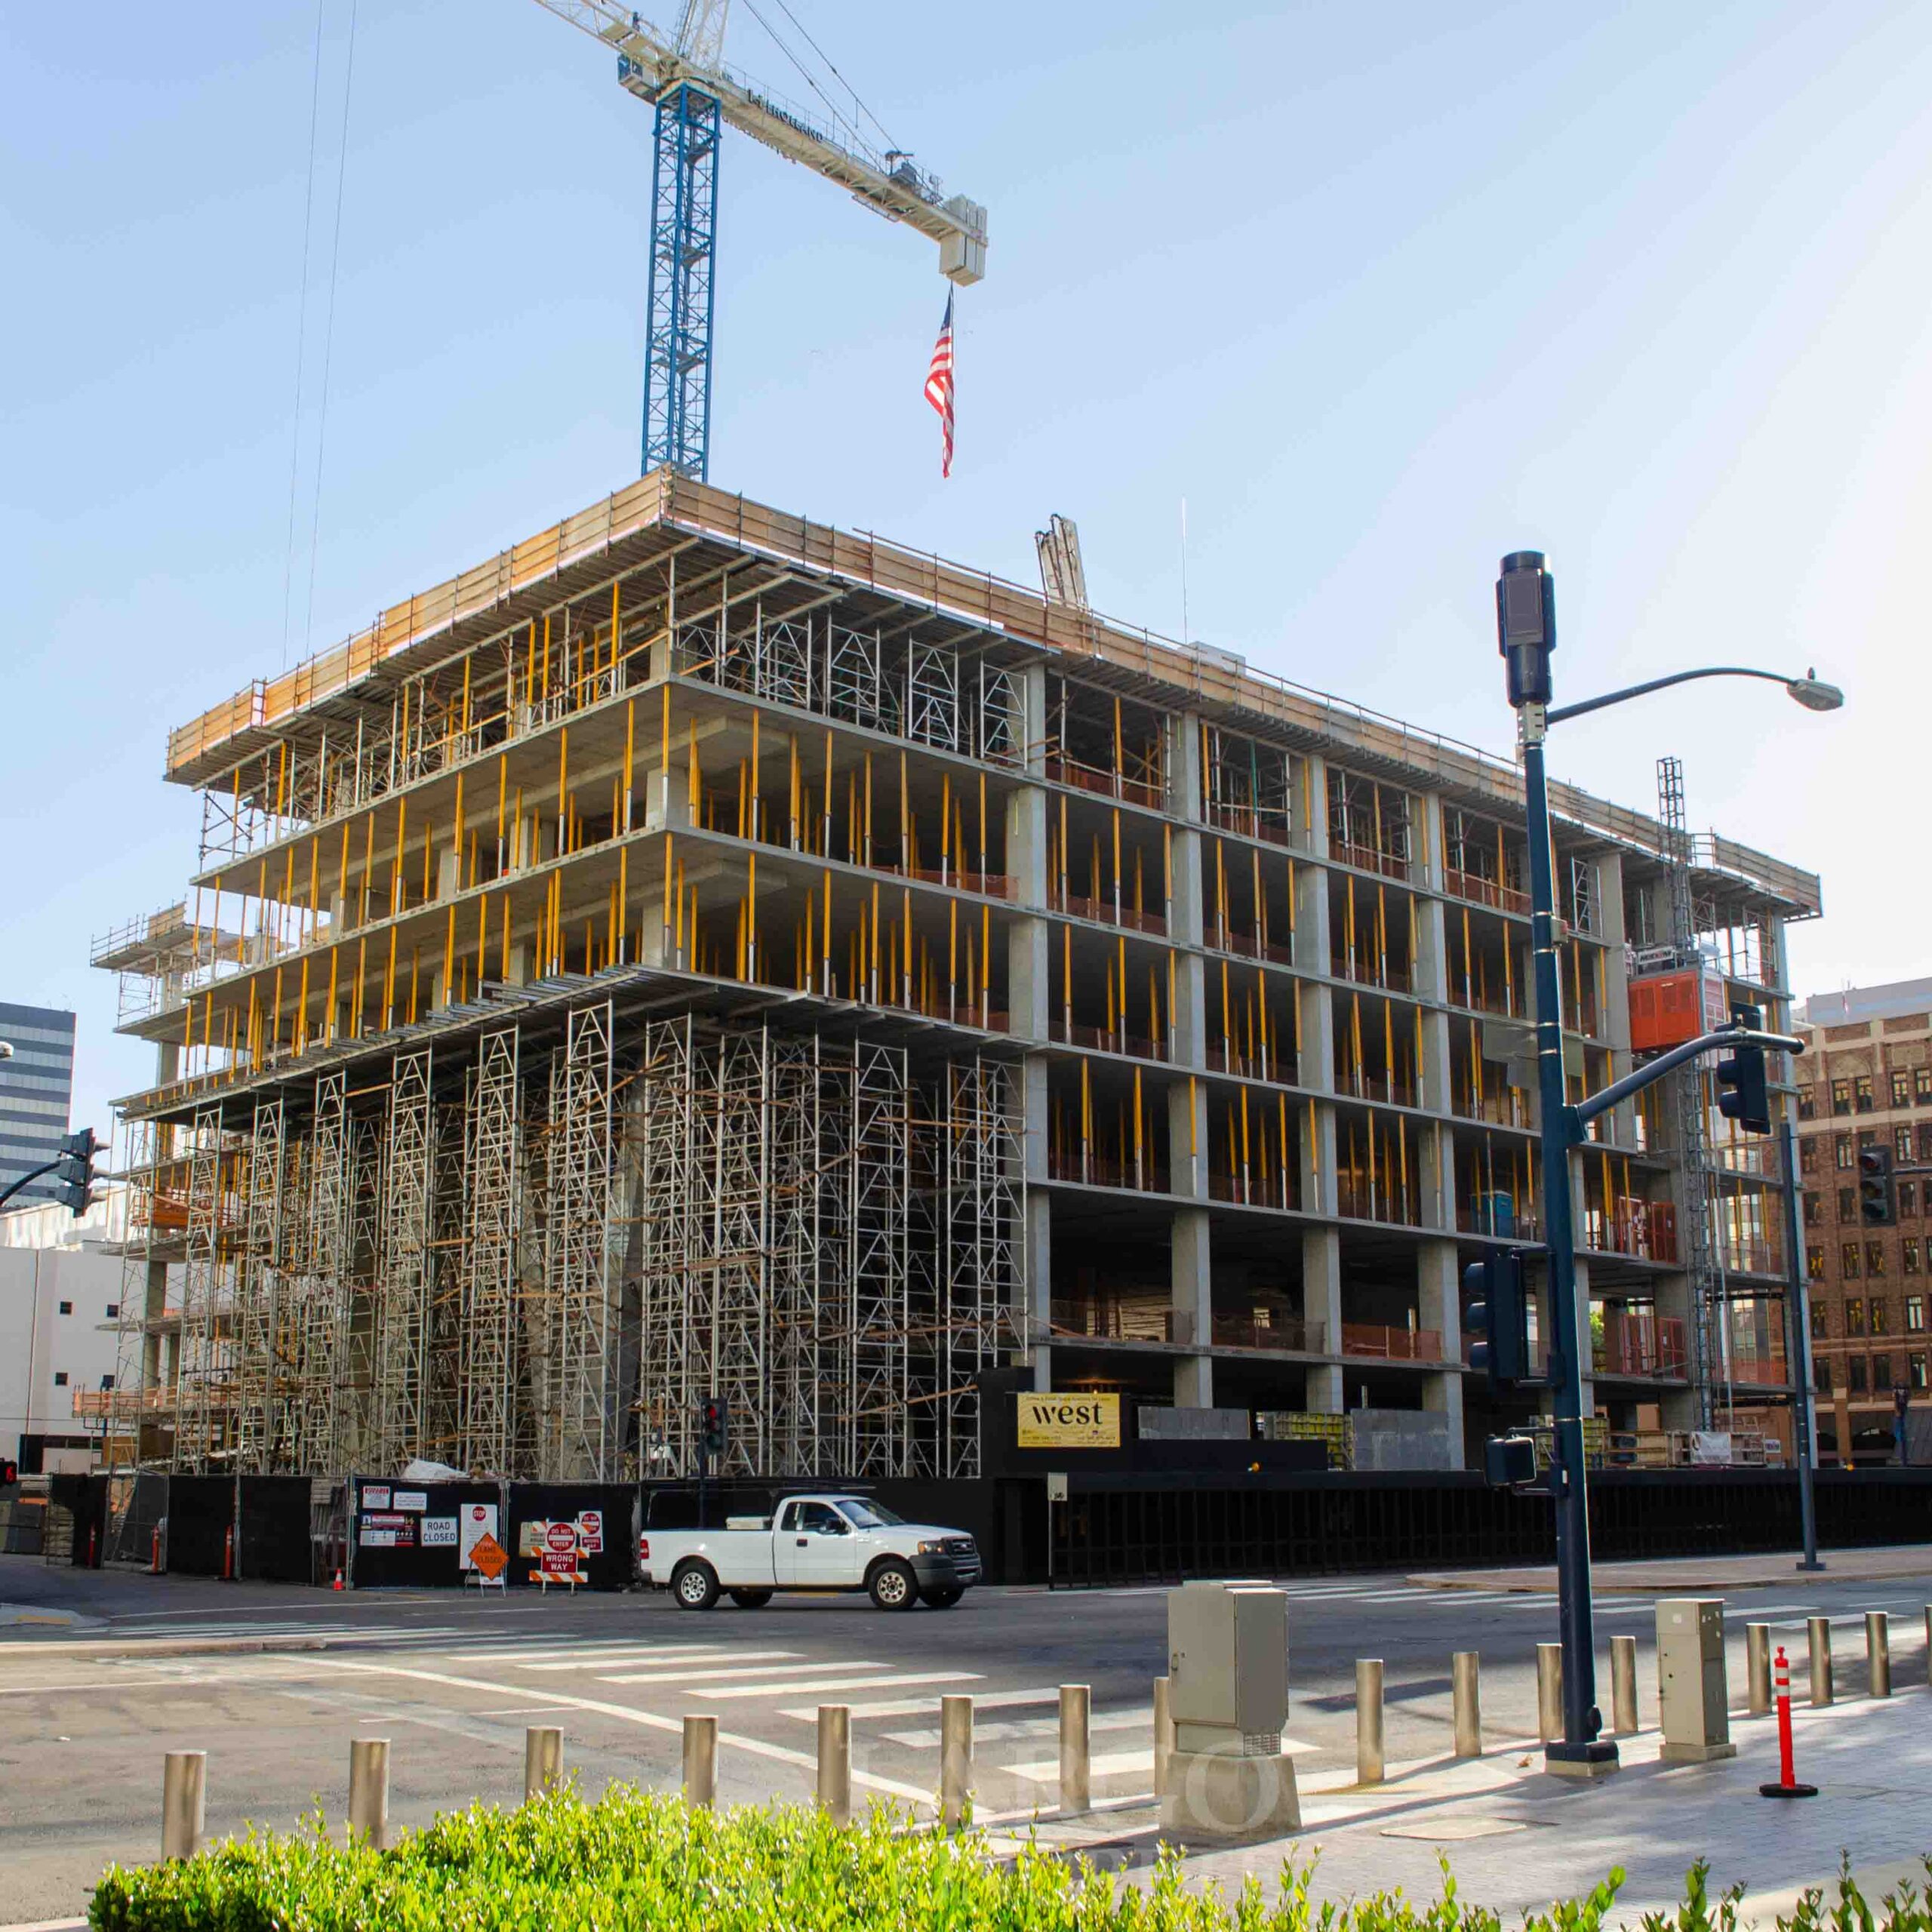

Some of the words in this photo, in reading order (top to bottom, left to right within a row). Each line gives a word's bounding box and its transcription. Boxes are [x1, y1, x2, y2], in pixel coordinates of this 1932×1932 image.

[1032, 1402, 1103, 1425] west
[427, 1521, 451, 1531] ROAD
[423, 1532, 456, 1542] CLOSED
[546, 1554, 574, 1562] WRONG
